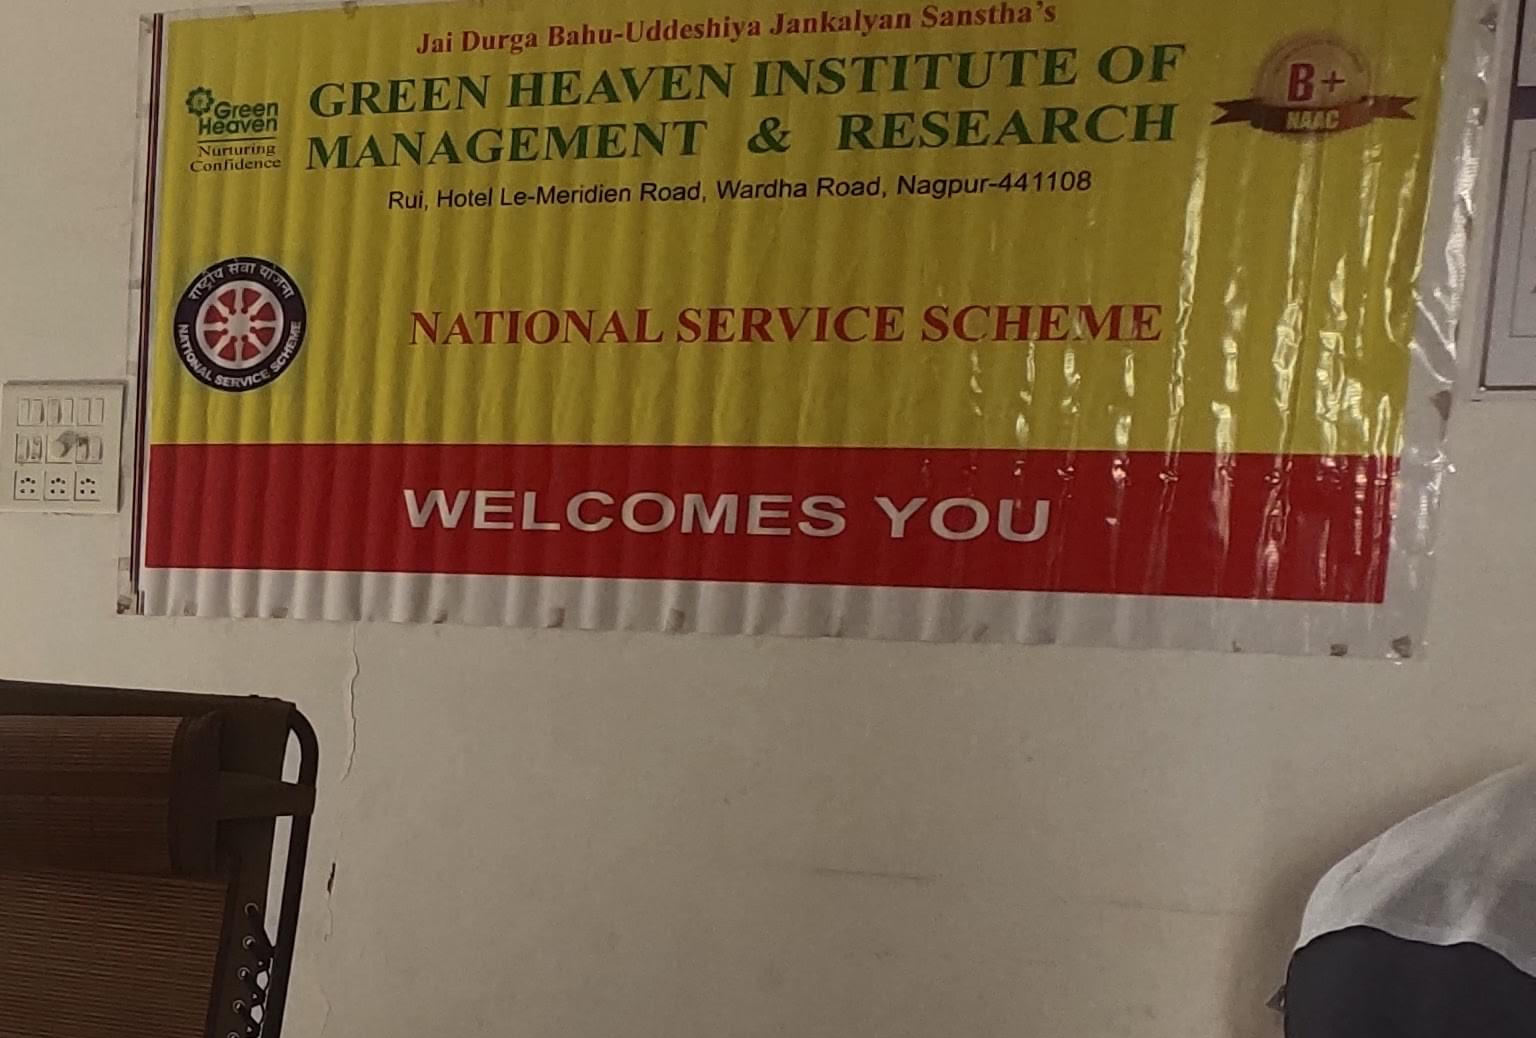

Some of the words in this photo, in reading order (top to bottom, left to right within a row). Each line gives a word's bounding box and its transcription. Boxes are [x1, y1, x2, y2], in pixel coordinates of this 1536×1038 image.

[416, 32, 453, 54] Jai
[461, 29, 538, 55] Durga
[548, 18, 761, 47] Bahu-Uddeshiya
[770, 9, 912, 36] Jankalyan
[309, 75, 492, 119] GREEN
[506, 62, 736, 108] HEAVEN
[751, 47, 1079, 97] INSTITUTE
[1097, 43, 1187, 83] OF
[1287, 63, 1346, 102] B+
[198, 117, 278, 135] Heaven
[214, 101, 279, 120] Green
[1285, 109, 1340, 130] NAAC
[198, 143, 276, 157] Nurturing
[306, 120, 708, 171] MANAGEMENT
[746, 116, 792, 154] &
[836, 103, 1180, 152] RESEARCH
[190, 158, 281, 173] Confidence
[388, 192, 429, 212] Rui,
[437, 187, 494, 209] Hotel
[500, 184, 631, 206] Le-Meridien
[639, 181, 707, 204] Road,
[717, 177, 808, 200] Wardha
[816, 176, 888, 200] Road,
[897, 169, 1093, 199] Nagpur-441108
[409, 308, 665, 345] NATIONAL
[676, 305, 905, 343] SERVICE
[921, 304, 1162, 342] SCHEME
[177, 323, 213, 382] NATIONAL
[214, 368, 271, 388] SERVICE
[271, 320, 302, 374] SCHEME
[403, 489, 846, 537] WELCOMES
[873, 496, 1051, 542] YOU
